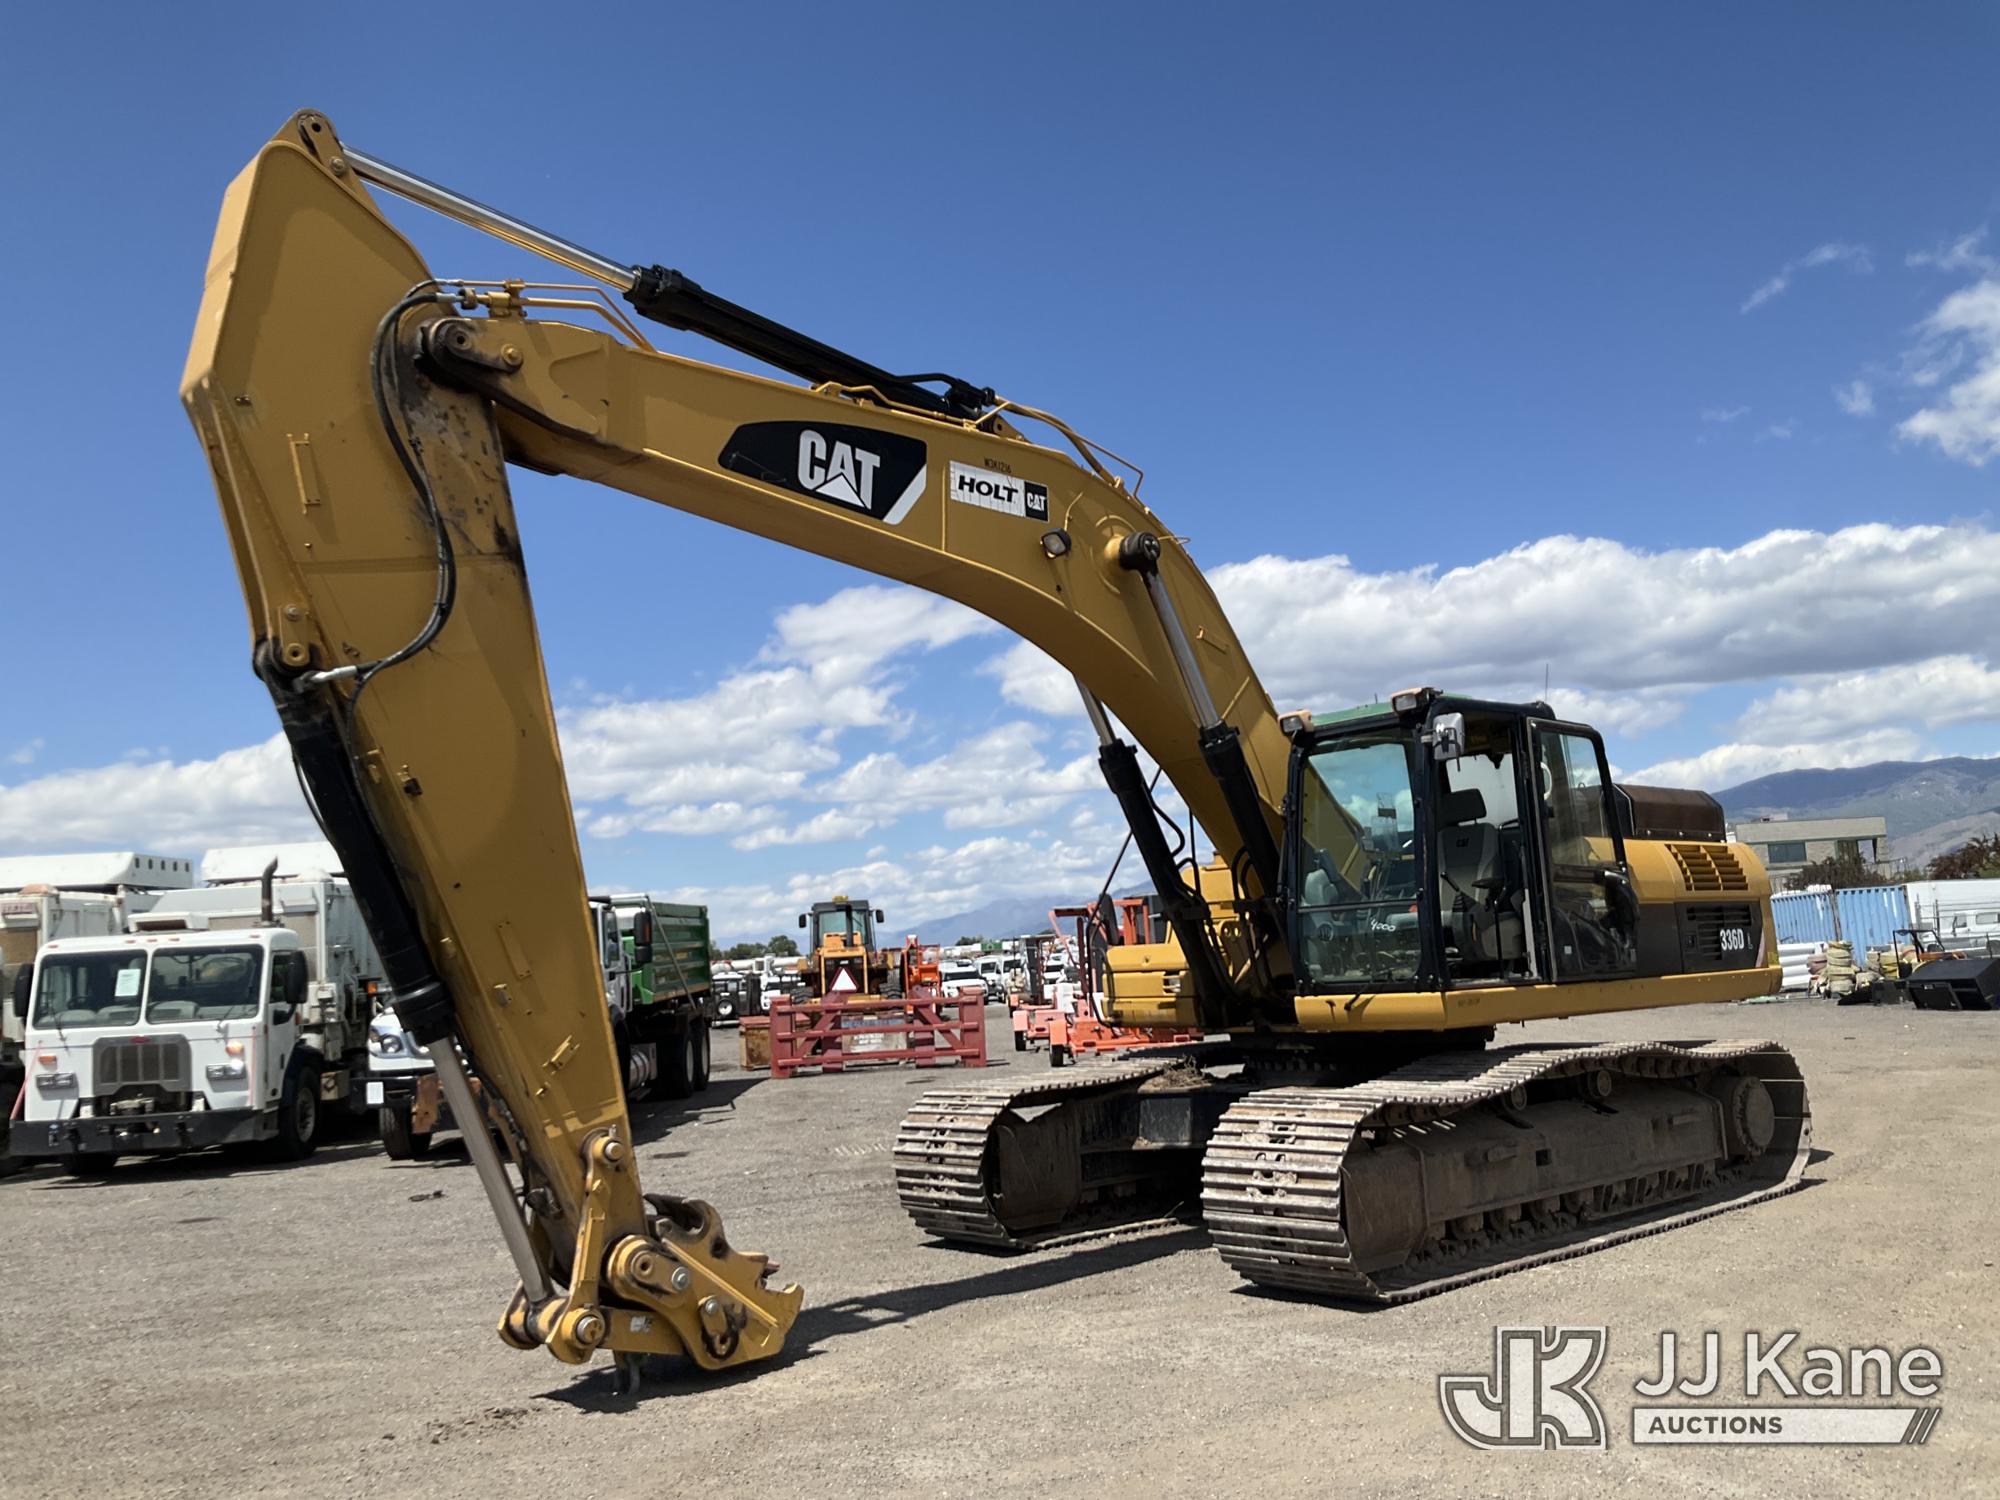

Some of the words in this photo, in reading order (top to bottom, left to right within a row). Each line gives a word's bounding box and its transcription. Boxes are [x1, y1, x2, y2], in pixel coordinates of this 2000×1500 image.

[798, 429, 880, 510] CAT
[958, 475, 1019, 503] HOLT
[1026, 492, 1046, 512] CAT
[1720, 928, 1745, 951] 336D
